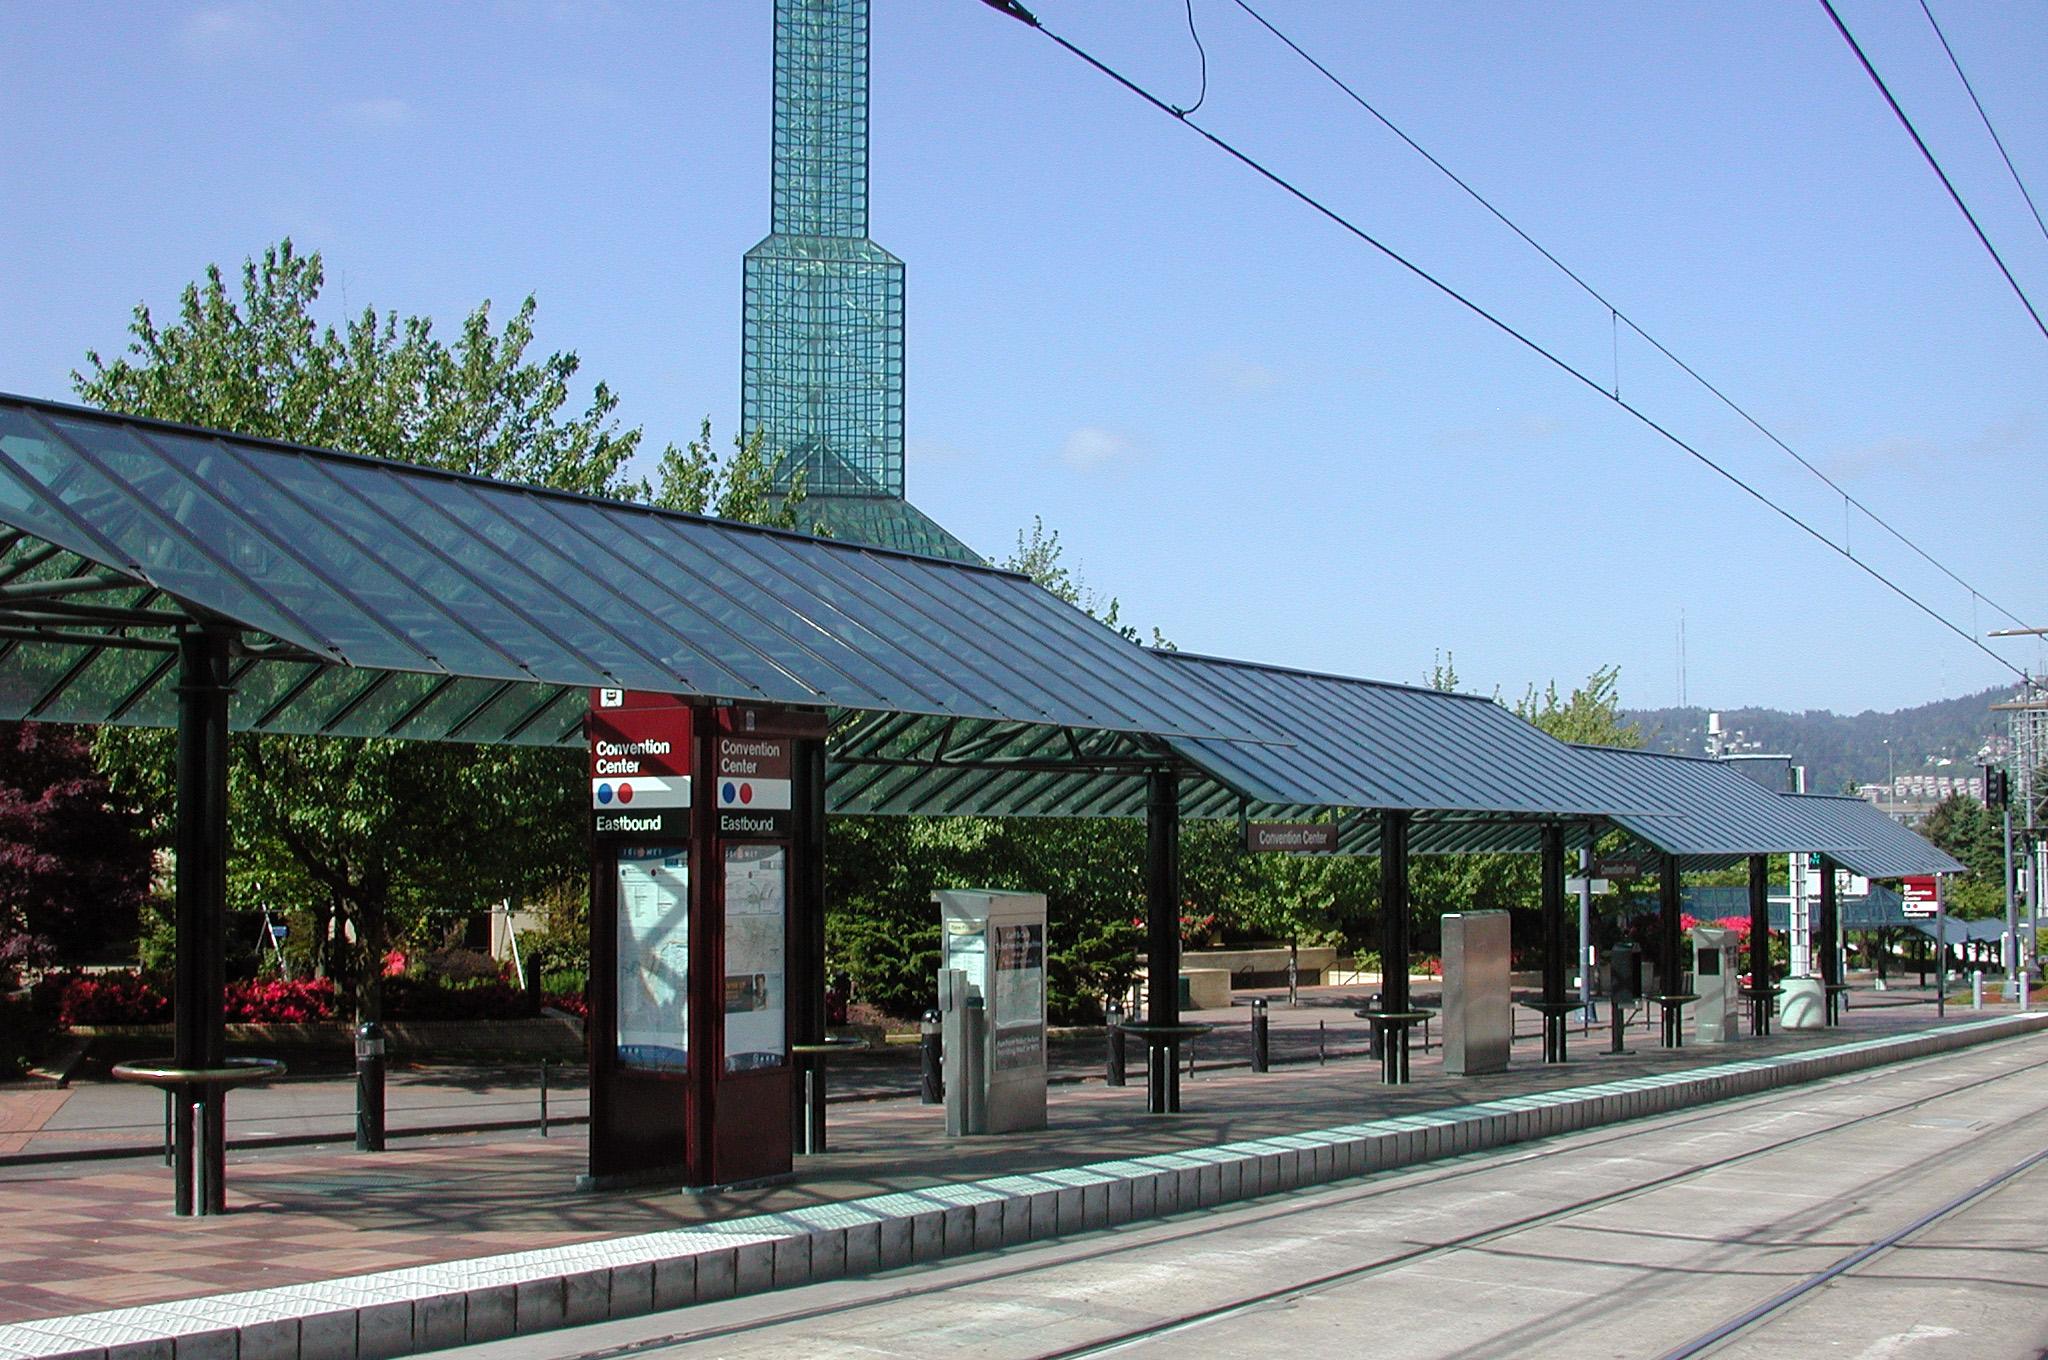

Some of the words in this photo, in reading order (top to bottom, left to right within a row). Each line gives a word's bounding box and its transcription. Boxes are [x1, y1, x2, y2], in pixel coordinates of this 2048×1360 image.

[596, 739, 670, 756] Convention
[721, 739, 780, 758] Convention
[596, 758, 640, 774] Center
[721, 758, 758, 774] Center
[596, 815, 662, 831] Eastbound
[721, 815, 774, 832] Eastbound
[1259, 830, 1302, 845] Convention
[1303, 830, 1327, 844] Center
